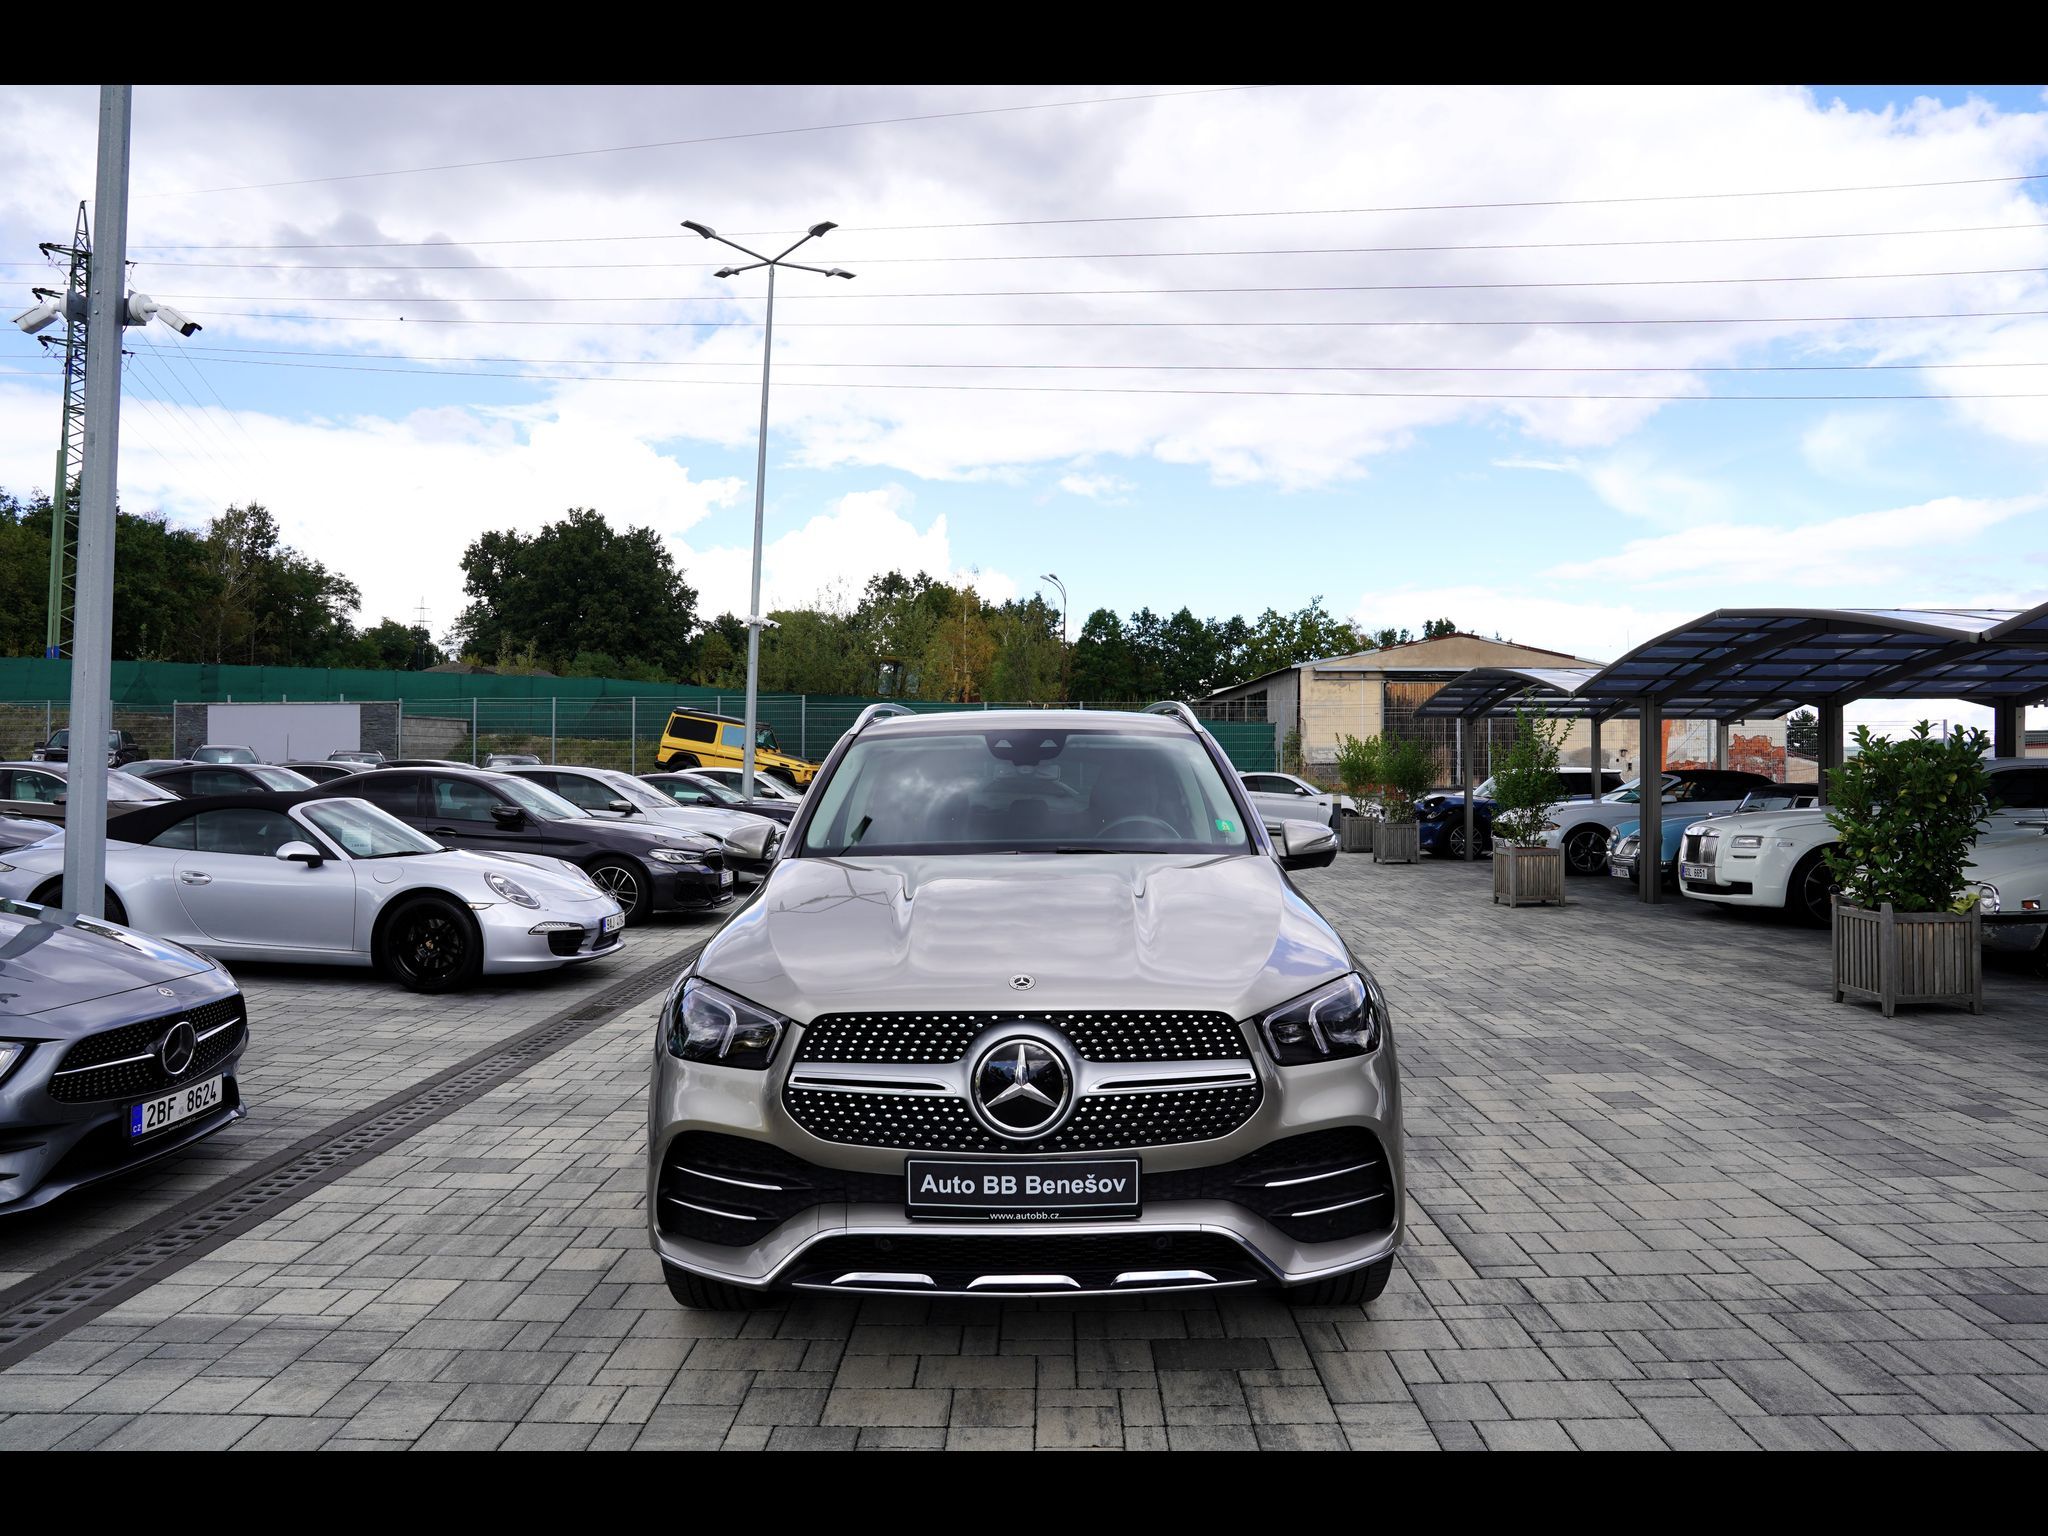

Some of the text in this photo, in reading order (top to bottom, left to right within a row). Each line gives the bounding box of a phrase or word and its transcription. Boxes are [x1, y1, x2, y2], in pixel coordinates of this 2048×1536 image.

[147, 1080, 217, 1129] 2BF 8624
[132, 1124, 142, 1133] CZ
[920, 1173, 1127, 1195] Auto BB Benešov
[989, 1211, 1060, 1221] www.autobb.cz
